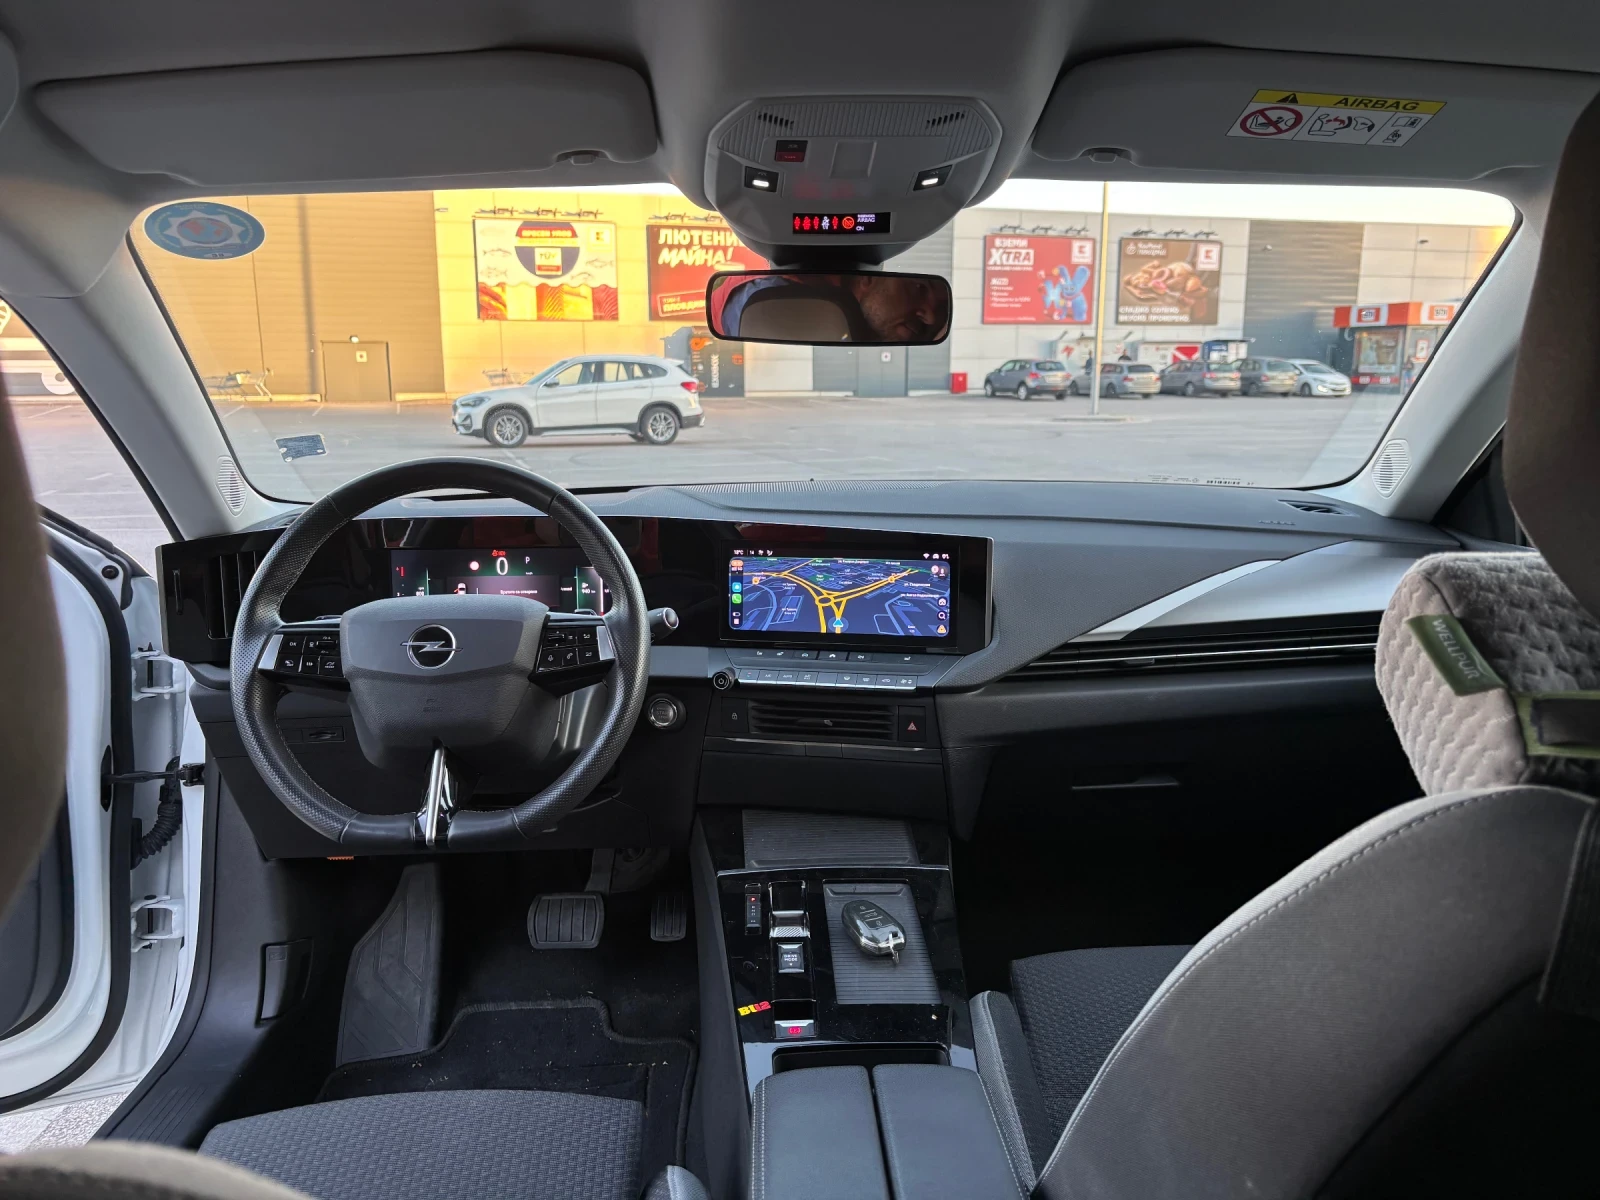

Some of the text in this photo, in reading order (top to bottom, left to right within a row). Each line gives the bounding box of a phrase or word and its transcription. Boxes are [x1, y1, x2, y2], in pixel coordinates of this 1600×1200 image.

[1333, 96, 1420, 111] AIRBAG
[658, 227, 746, 247] ЛЮТЕНИ
[657, 244, 735, 269] МАЙНА!
[495, 556, 509, 576] 0
[525, 556, 531, 564] P
[1432, 618, 1480, 680] WELLPUR
